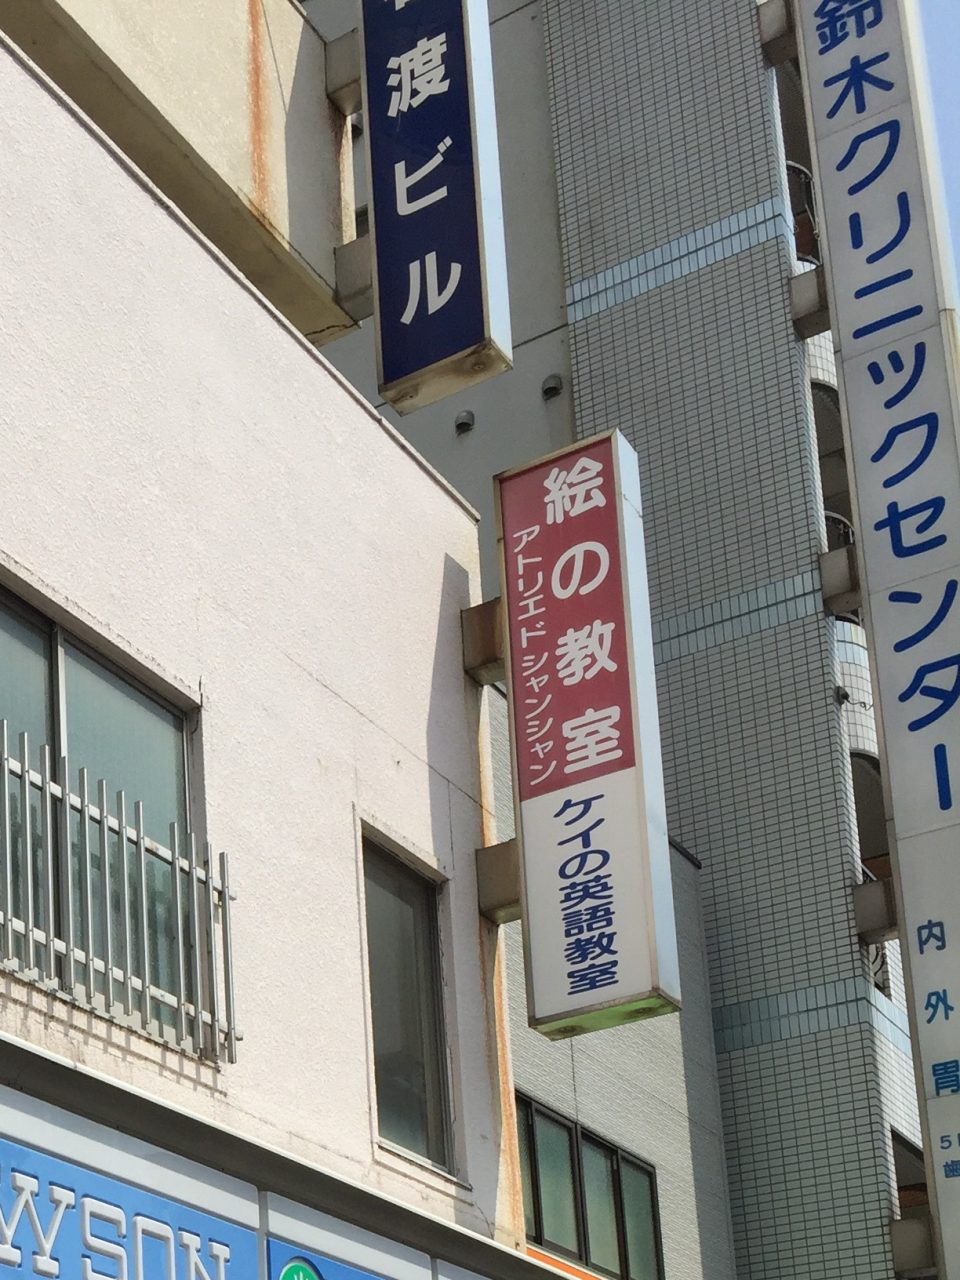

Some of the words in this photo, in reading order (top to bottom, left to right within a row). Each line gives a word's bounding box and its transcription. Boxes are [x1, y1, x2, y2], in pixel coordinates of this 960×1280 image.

[386, 0, 462, 325] 渡ビル
[543, 456, 623, 776] 絵の教室
[553, 793, 619, 996] ケイの英語教室
